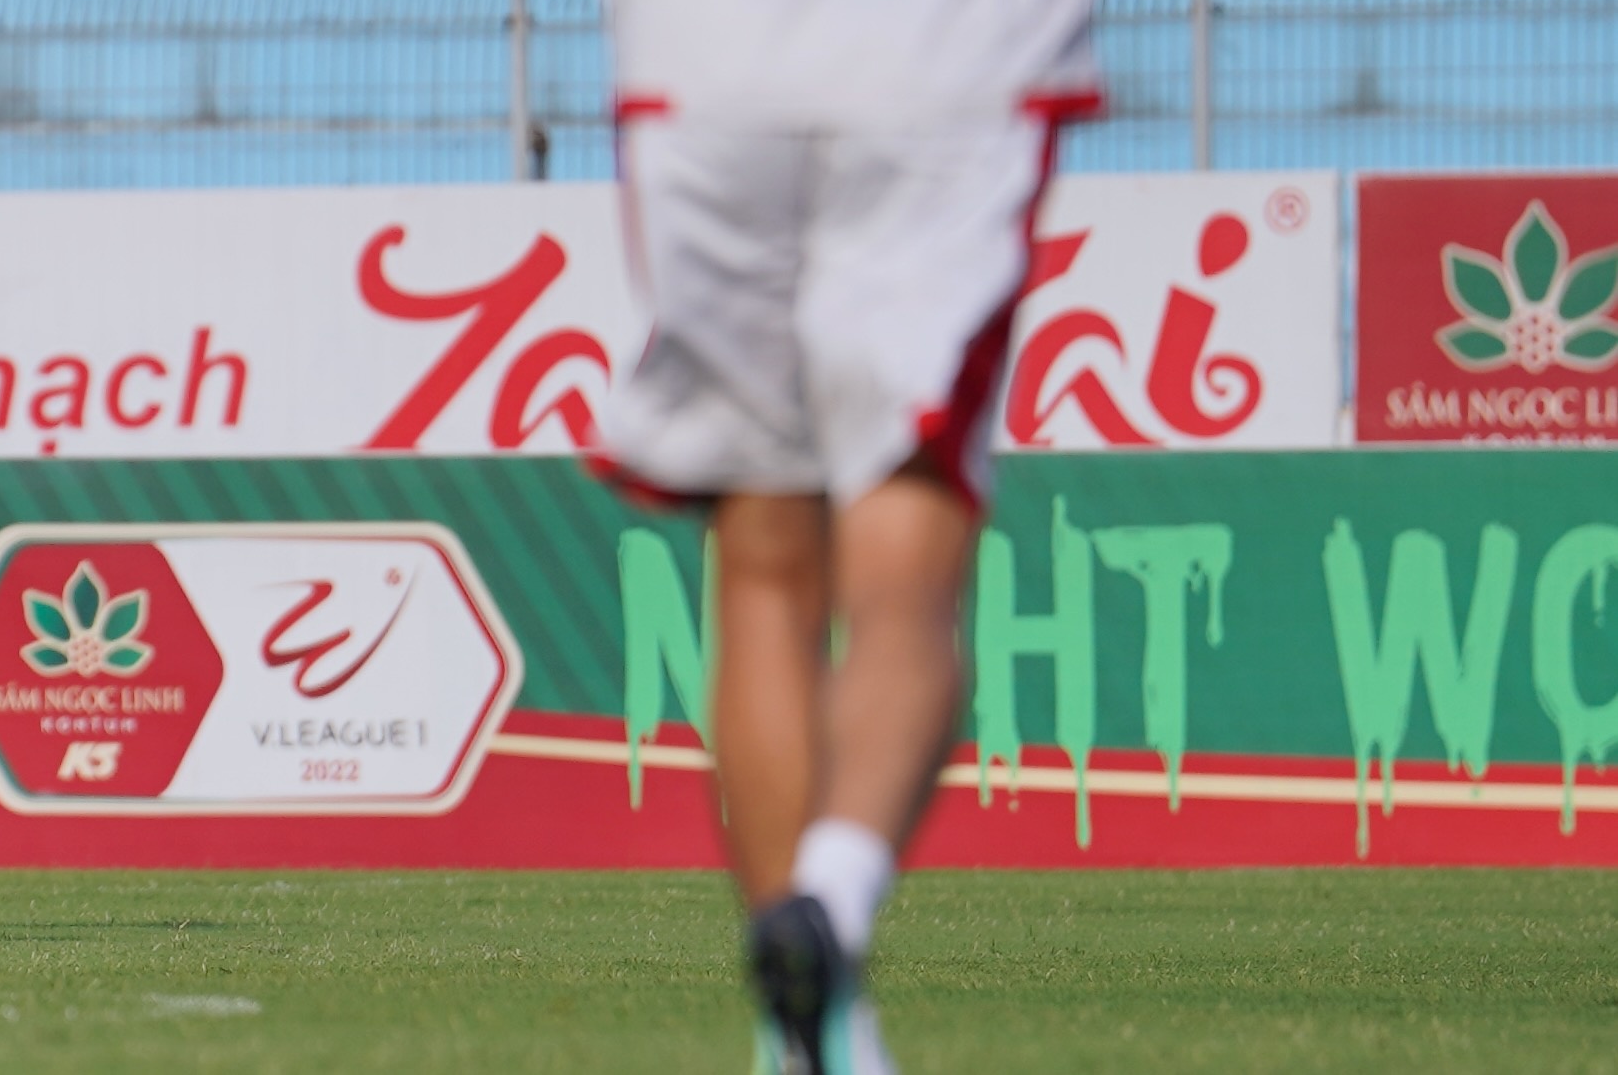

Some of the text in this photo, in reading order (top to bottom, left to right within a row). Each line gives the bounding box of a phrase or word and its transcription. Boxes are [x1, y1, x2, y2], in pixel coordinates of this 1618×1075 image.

[619, 493, 1618, 859] NHT WO
[44, 685, 118, 714] NGỌC
[121, 686, 186, 712] LINH
[251, 718, 408, 747] V.LEAGUE
[299, 758, 361, 782] 2022
